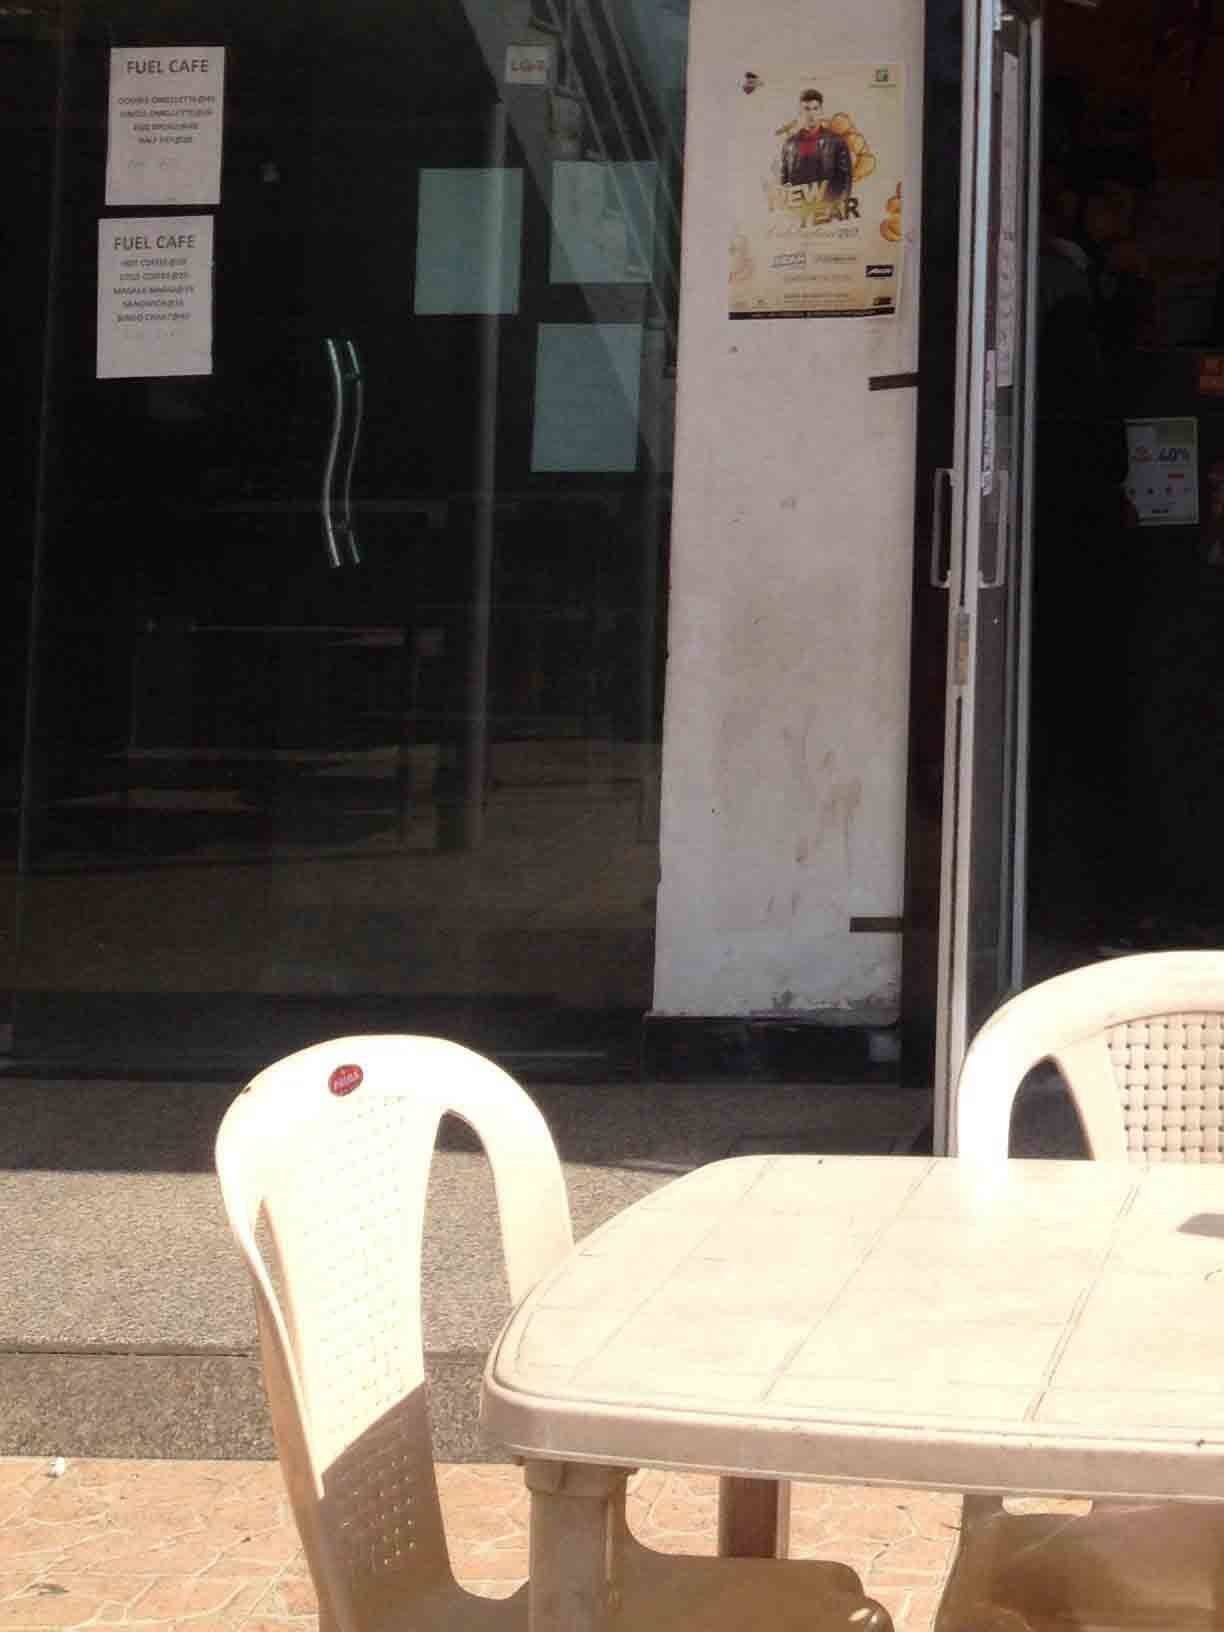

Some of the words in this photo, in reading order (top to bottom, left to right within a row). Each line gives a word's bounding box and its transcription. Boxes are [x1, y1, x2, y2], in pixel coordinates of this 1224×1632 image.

[126, 60, 163, 75] FUEL
[168, 59, 209, 73] CAFE
[799, 196, 862, 228] YEAR
[113, 236, 153, 251] FUEL
[156, 235, 197, 249] CAFE
